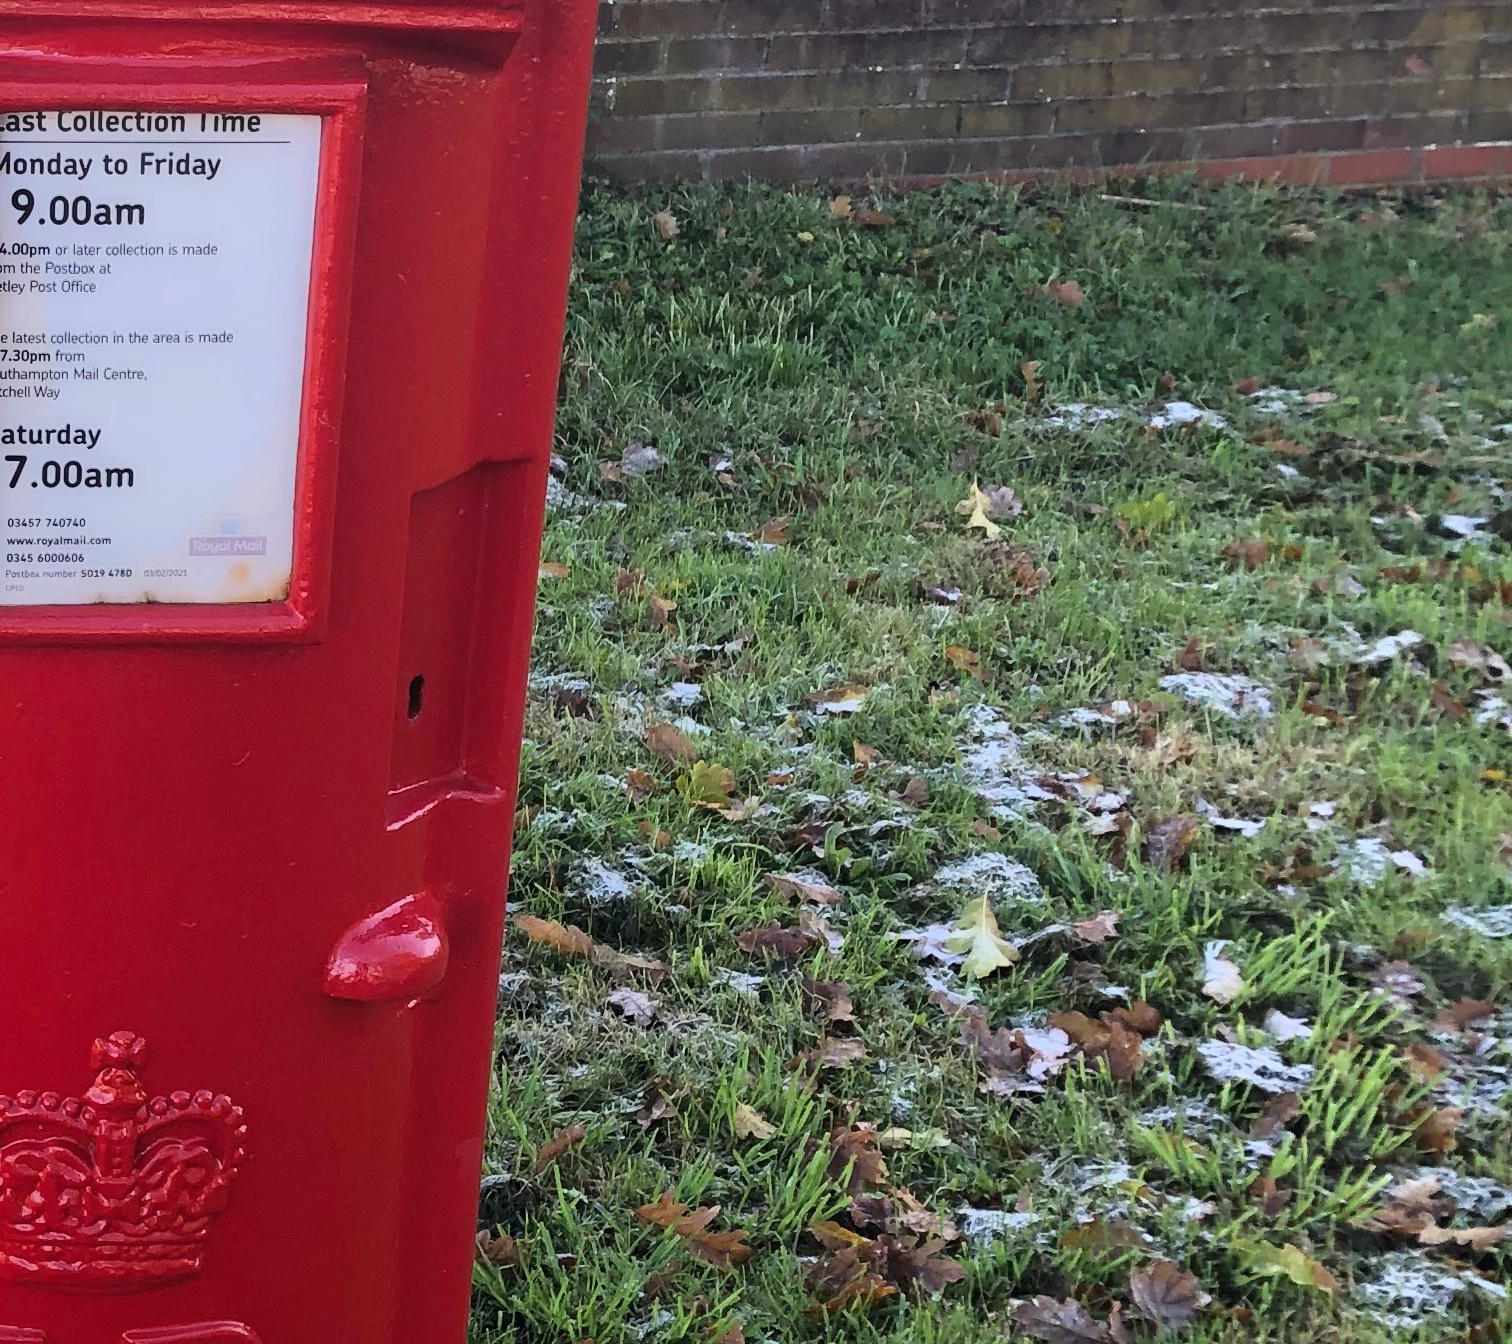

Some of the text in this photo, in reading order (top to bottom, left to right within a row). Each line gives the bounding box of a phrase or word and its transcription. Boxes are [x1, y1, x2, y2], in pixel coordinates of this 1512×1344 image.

[57, 111, 185, 133] Collection
[103, 154, 128, 175] to
[140, 152, 221, 180] Friday
[11, 188, 145, 225] 9.00am
[0, 243, 50, 258] 4.00pm
[55, 246, 68, 256] or
[73, 243, 102, 256] later
[105, 243, 164, 256] collection
[168, 243, 178, 256] is
[182, 242, 218, 256] made
[20, 262, 41, 275] the
[45, 261, 95, 275] Postbox
[99, 263, 112, 275] at
[30, 280, 57, 293] Post
[61, 280, 96, 293] Office
[12, 332, 46, 344] latest
[50, 331, 109, 344] collection
[113, 331, 124, 344] in
[129, 331, 149, 344] the
[153, 333, 180, 344] area
[184, 331, 194, 344] is
[198, 331, 234, 344] made
[0, 350, 50, 364] 7.30pm
[55, 350, 85, 362] from
[73, 367, 99, 380] Mail
[103, 367, 147, 381] Centre,
[34, 386, 60, 400] Way
[5, 455, 134, 489] 7.00am
[7, 518, 86, 528] 03457 740740
[7, 535, 111, 546] www.royalmail.com
[193, 539, 264, 554] Royal Mail
[6, 553, 85, 563] 0345 6000606
[5, 569, 40, 579] Postbox
[42, 570, 77, 578] number
